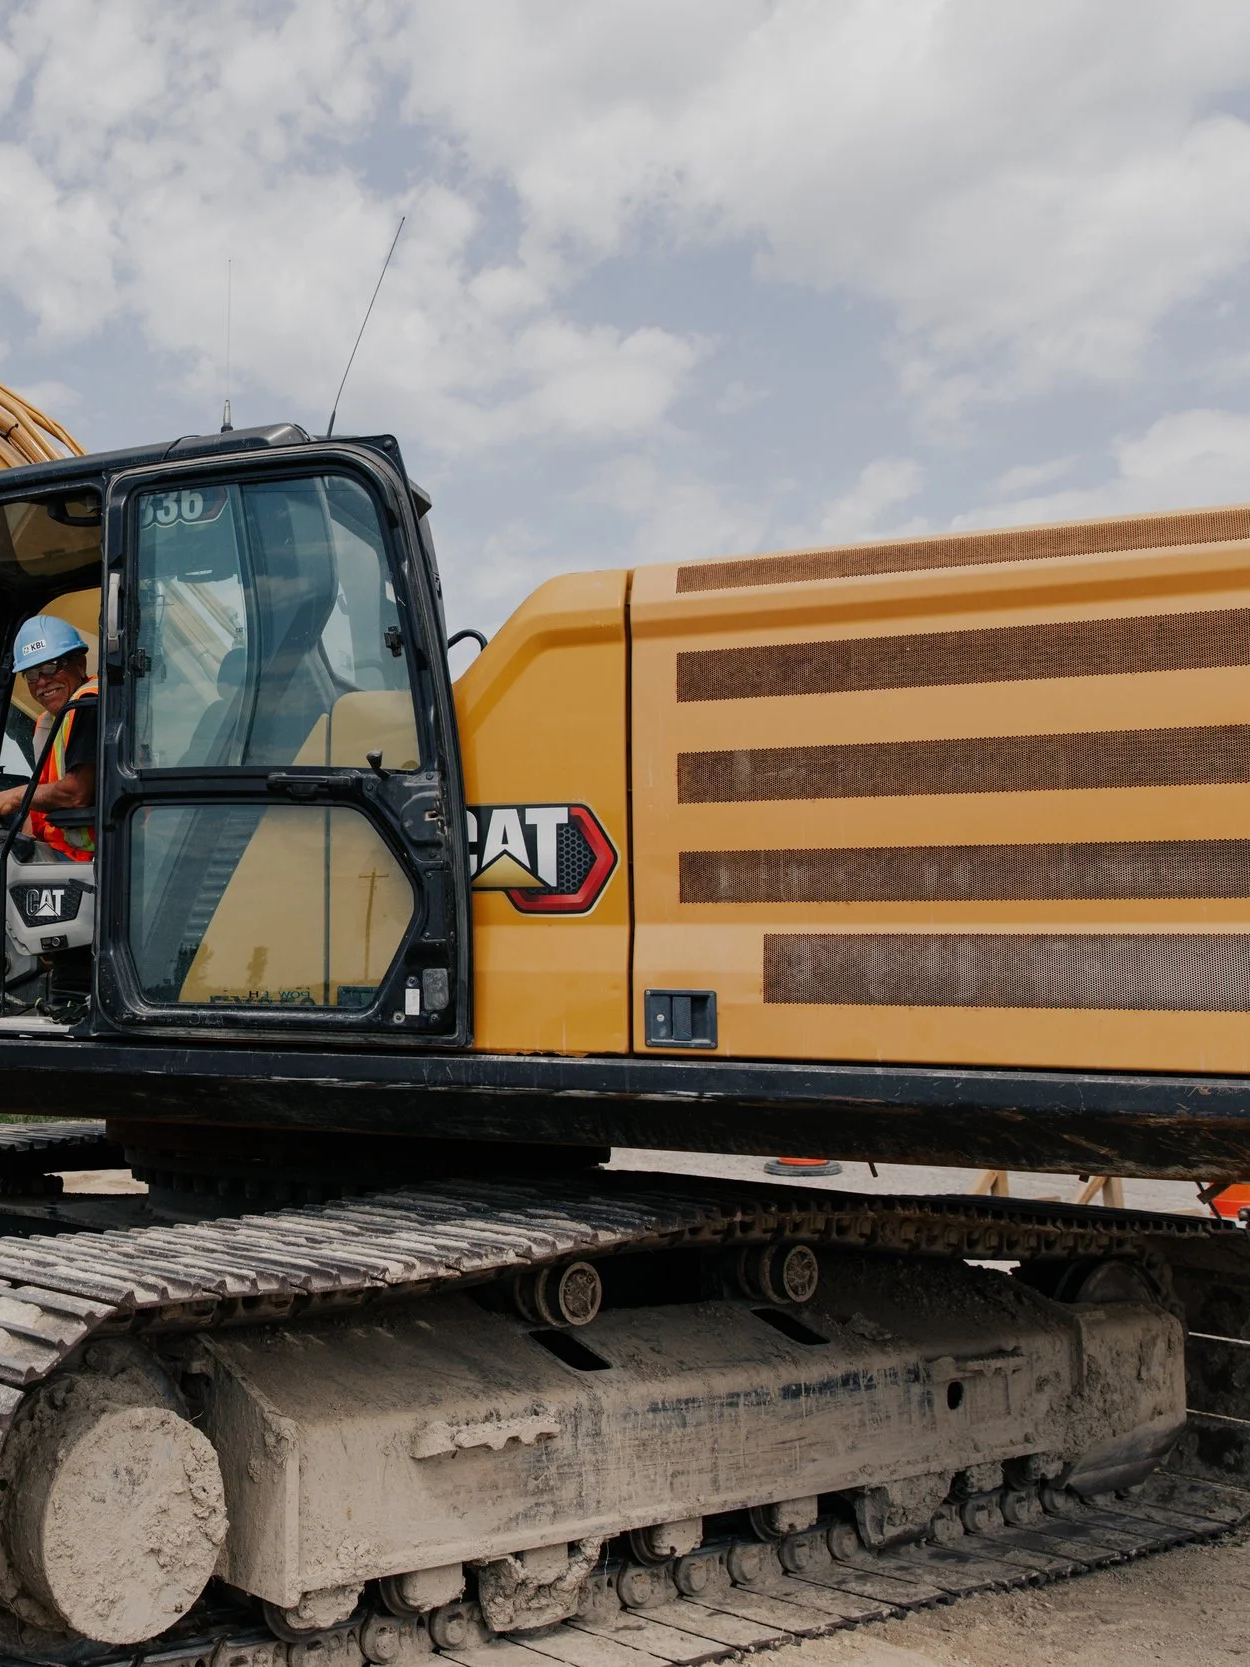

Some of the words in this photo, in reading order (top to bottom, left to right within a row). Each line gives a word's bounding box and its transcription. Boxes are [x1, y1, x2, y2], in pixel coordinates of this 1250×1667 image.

[31, 641, 46, 651] KBL
[466, 807, 569, 888] AT
[26, 889, 65, 917] CAT
